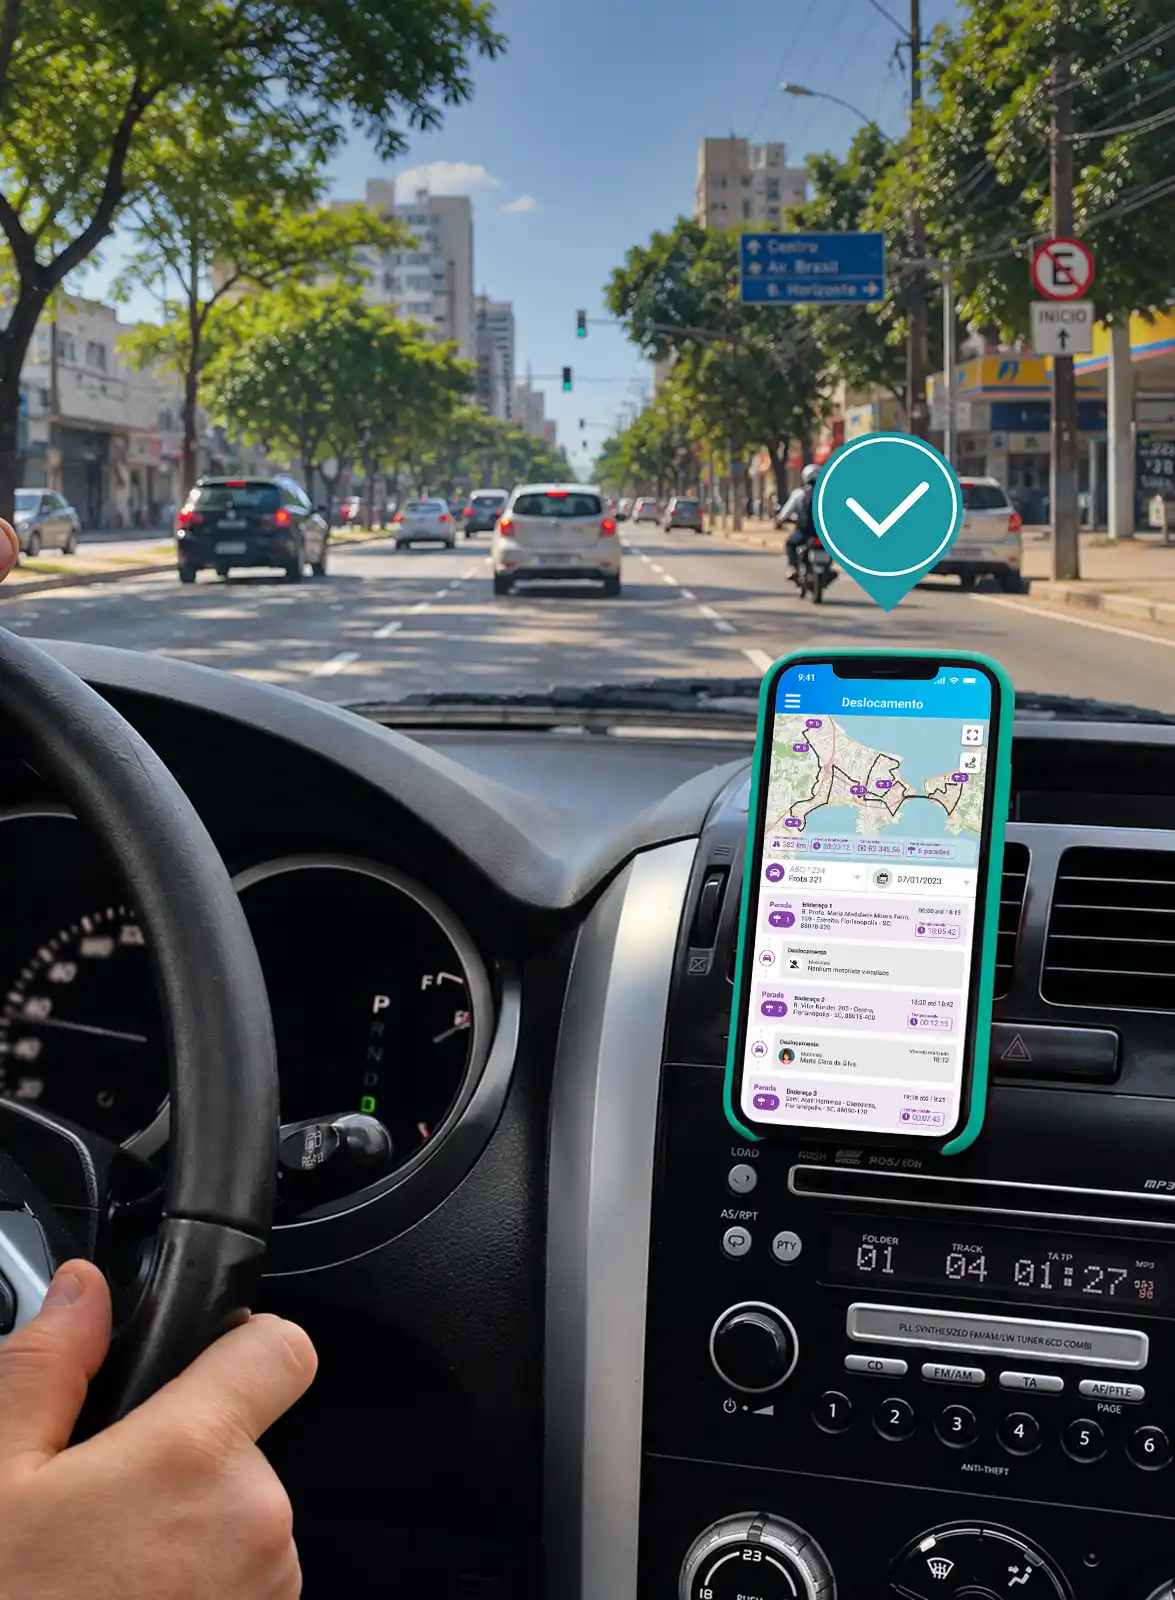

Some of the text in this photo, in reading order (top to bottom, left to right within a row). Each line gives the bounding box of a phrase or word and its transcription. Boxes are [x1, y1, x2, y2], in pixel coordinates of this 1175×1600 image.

[794, 259, 839, 274] Brasil
[1053, 252, 1074, 285] E
[787, 283, 857, 297] Horizonte
[798, 674, 815, 682] 9:41
[842, 697, 923, 710] Deslocamento
[898, 876, 942, 885] 07/01/2023
[421, 975, 433, 990] F
[373, 995, 390, 1014] P
[360, 1096, 376, 1113] D
[731, 1147, 759, 1158] LOAD
[720, 1209, 759, 1220] AS/RPT
[777, 1240, 796, 1250] PTY
[862, 1234, 899, 1245] FOLDER
[952, 1243, 983, 1253] TRACK
[857, 1244, 894, 1273] 01
[946, 1253, 987, 1282] 04
[1015, 1260, 1127, 1295] 01:27
[899, 1323, 912, 1332] PLL
[1017, 1335, 1043, 1345] TUNER
[1064, 1340, 1092, 1350] COMBI
[868, 1360, 883, 1370] CD
[934, 1368, 972, 1380] FM/AM
[1023, 1377, 1037, 1387] TA
[829, 1403, 836, 1418] 1
[1097, 1403, 1122, 1414] PAGE
[890, 1410, 899, 1424] 2
[952, 1417, 961, 1431] 3
[1014, 1424, 1024, 1438] 4
[1080, 1431, 1089, 1445] 5
[1144, 1438, 1154, 1452] 6
[962, 1464, 1009, 1475] ANTI-THEFT
[743, 1550, 762, 1562] 23
[700, 1588, 712, 1599] 18
